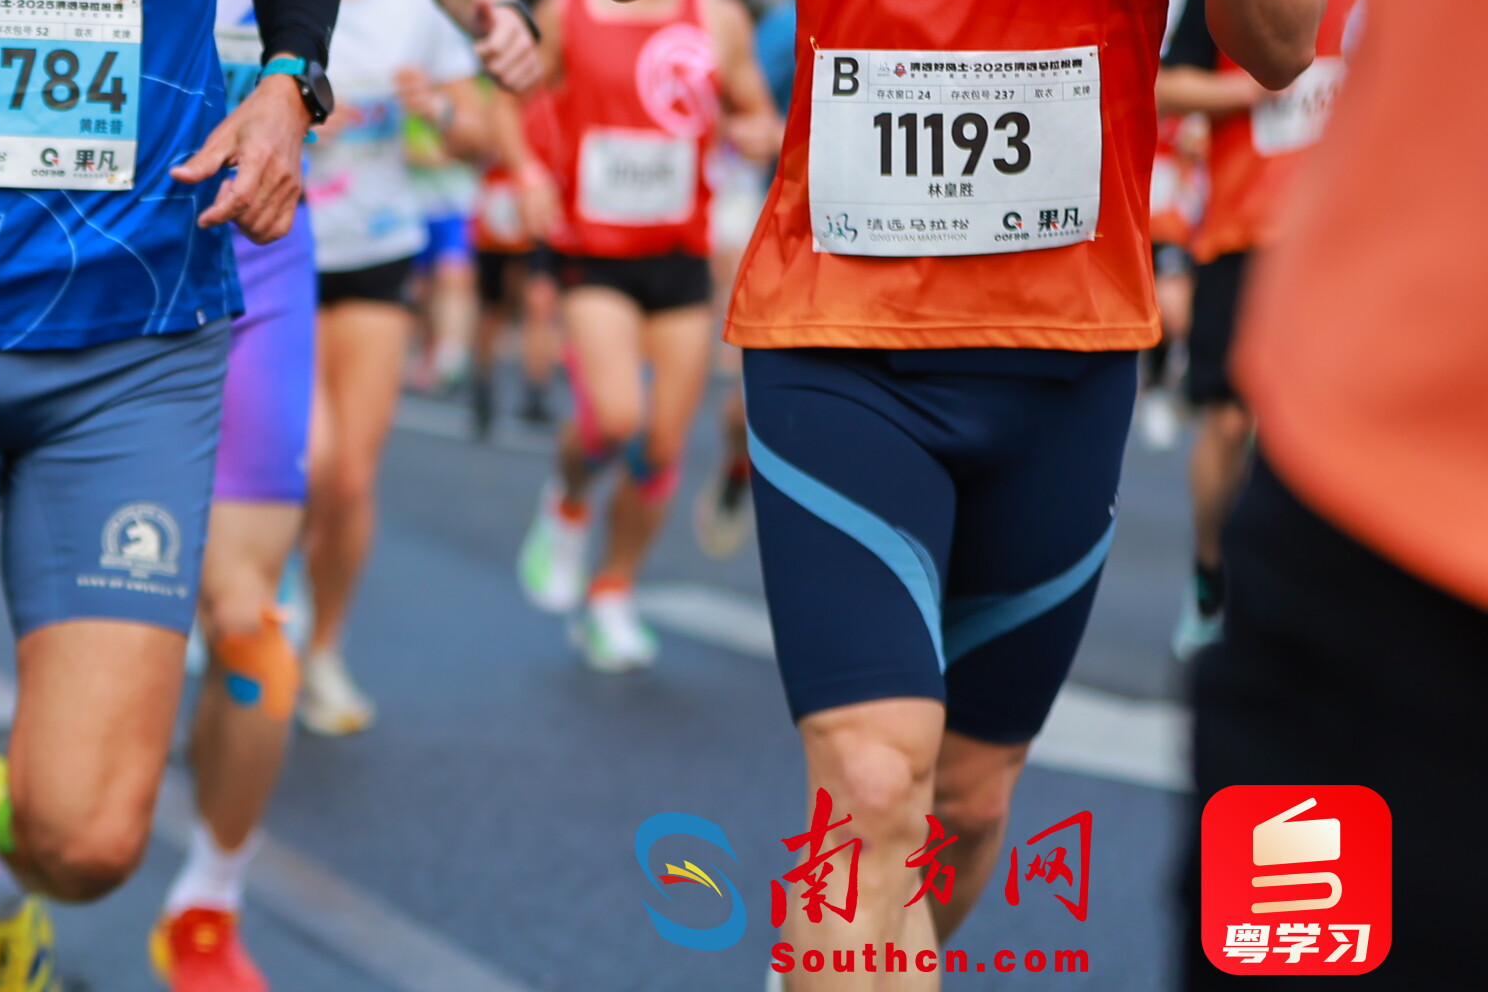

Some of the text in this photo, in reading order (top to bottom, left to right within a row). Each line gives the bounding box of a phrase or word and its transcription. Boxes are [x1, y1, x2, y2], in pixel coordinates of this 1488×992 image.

[75, 28, 93, 38] 取衣
[832, 56, 859, 97] B
[877, 90, 931, 100] 存衣窗口 24
[951, 90, 1015, 100] 存衣包号 237
[1034, 89, 1054, 99] 取衣
[873, 111, 1032, 177] 11193
[74, 149, 118, 171] 果凡
[927, 182, 975, 198] 林皇胜
[867, 218, 970, 232] 清远马拉松
[1037, 207, 1083, 232] 果凡
[869, 233, 968, 242] QINGYUAN MARATHON
